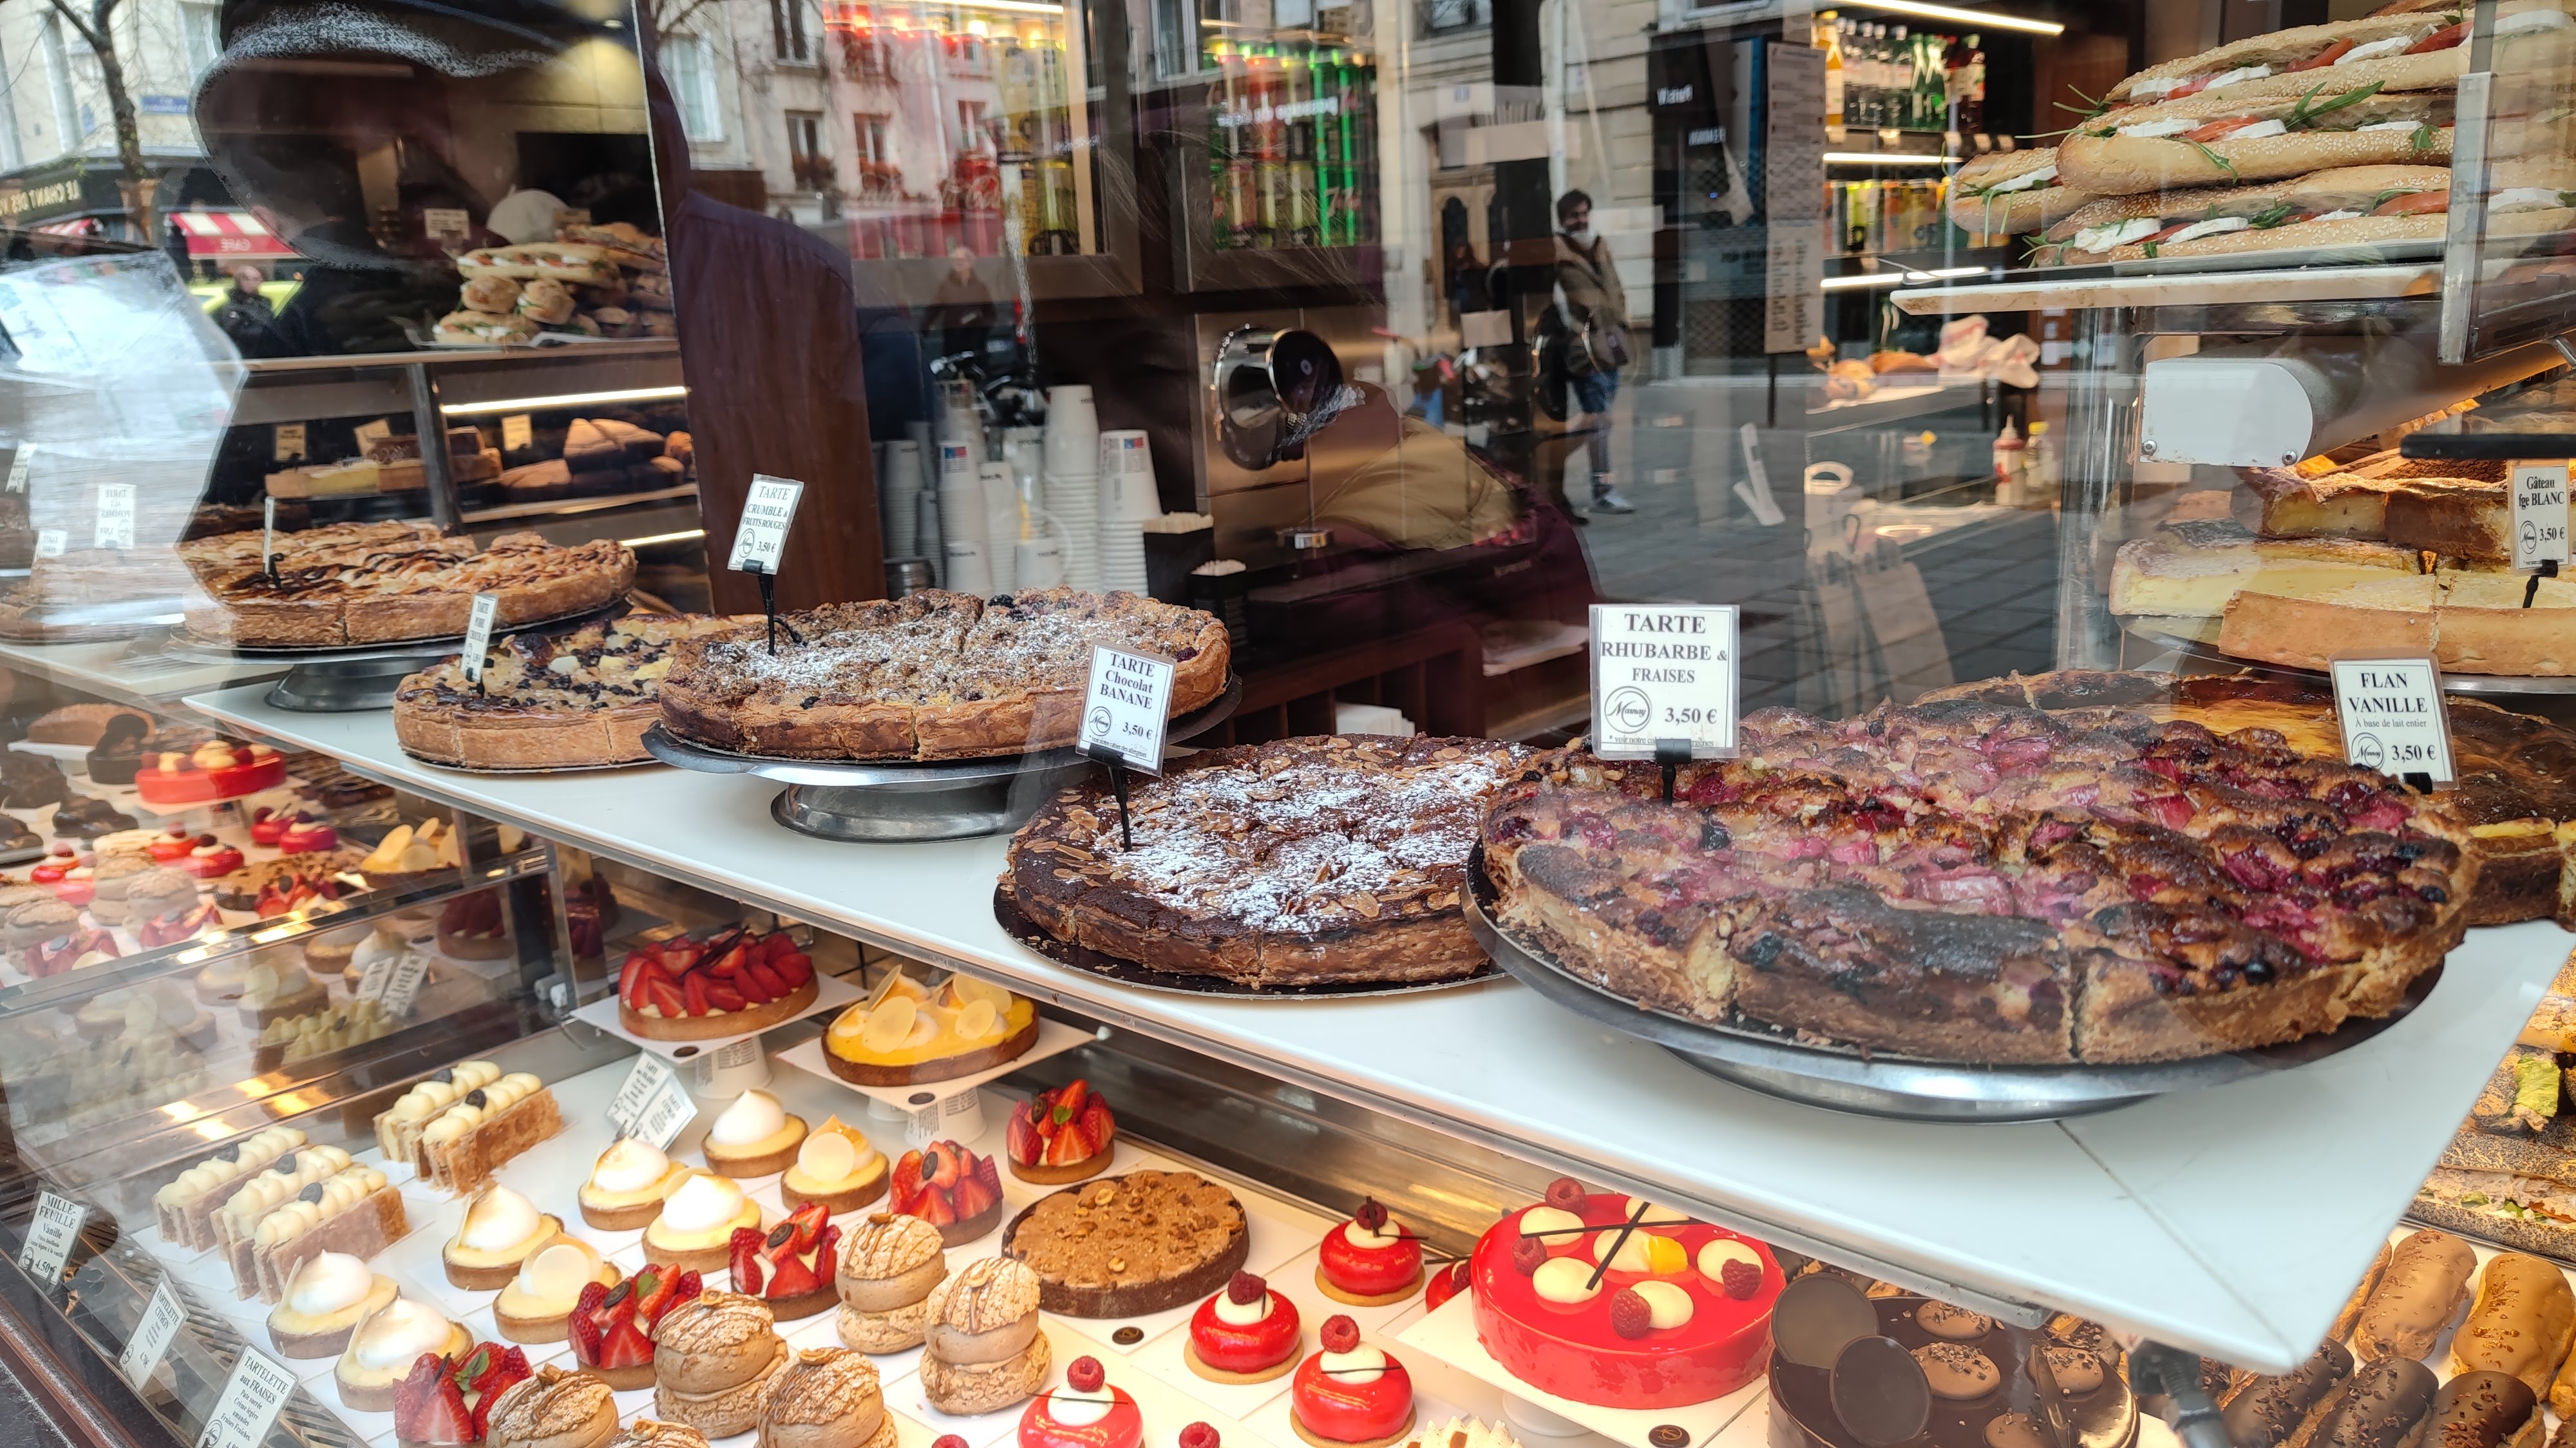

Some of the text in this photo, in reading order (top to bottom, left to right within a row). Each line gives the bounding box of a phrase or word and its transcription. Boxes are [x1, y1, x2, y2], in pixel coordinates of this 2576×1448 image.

[2526, 475, 2555, 490] Gâteau
[759, 486, 790, 500] TARTE
[2519, 491, 2564, 510] fge BLANC
[747, 504, 783, 517] CRUMBLE
[743, 517, 786, 529] FRUITS ROUGES
[2539, 527, 2557, 544] 3,50
[2560, 526, 2565, 540] €
[757, 541, 771, 553] 3,50
[771, 543, 777, 553] €
[1624, 614, 1706, 634] TARTE
[1601, 642, 1727, 661] RHUBARBE &
[1110, 653, 1155, 677] TARTE
[1106, 670, 1153, 693] Chocolat
[1631, 668, 1695, 683] FRAISES
[2360, 672, 2408, 689] FLAN
[1100, 683, 1153, 709] BANANE
[2348, 697, 2428, 713] VANILLE
[1664, 707, 1717, 725] 3,50 €
[2355, 717, 2427, 728] À base de lait entier
[1122, 722, 1153, 740] 3,50 €
[2391, 745, 2436, 763] 3,50 €
[45, 1194, 76, 1215] MILLE-
[39, 1205, 76, 1230] FEUILLE
[43, 1223, 62, 1239] Vanille
[156, 1289, 180, 1326] TARTELETTE
[155, 1306, 169, 1330] CITRON
[244, 1355, 289, 1395] TARTELETTE
[240, 1375, 277, 1405] aux FRAISES
[221, 1413, 234, 1428] Fraises
[232, 1411, 250, 1427] amandes
